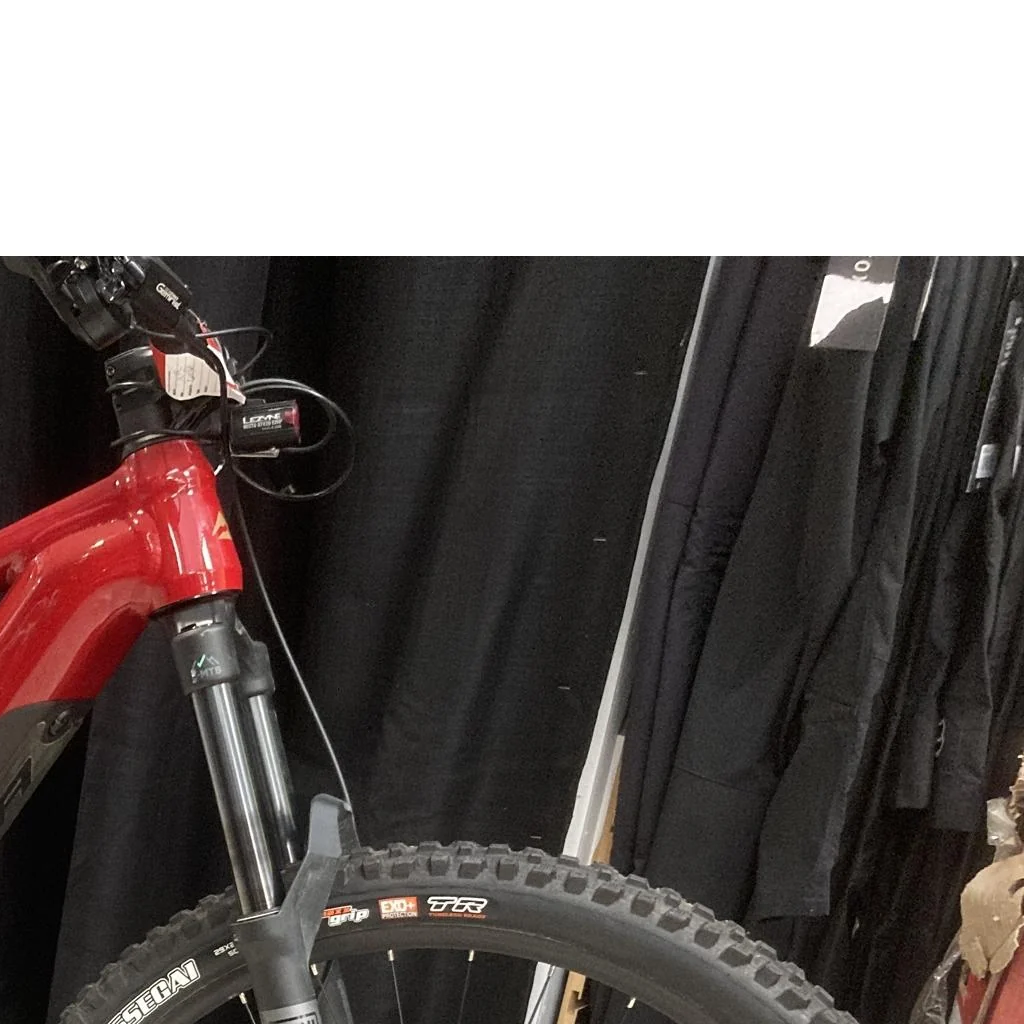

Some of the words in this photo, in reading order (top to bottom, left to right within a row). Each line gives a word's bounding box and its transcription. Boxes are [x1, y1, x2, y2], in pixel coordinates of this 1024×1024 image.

[242, 412, 281, 425] LEZYNE
[427, 896, 488, 914] TR
[328, 908, 370, 927] grip
